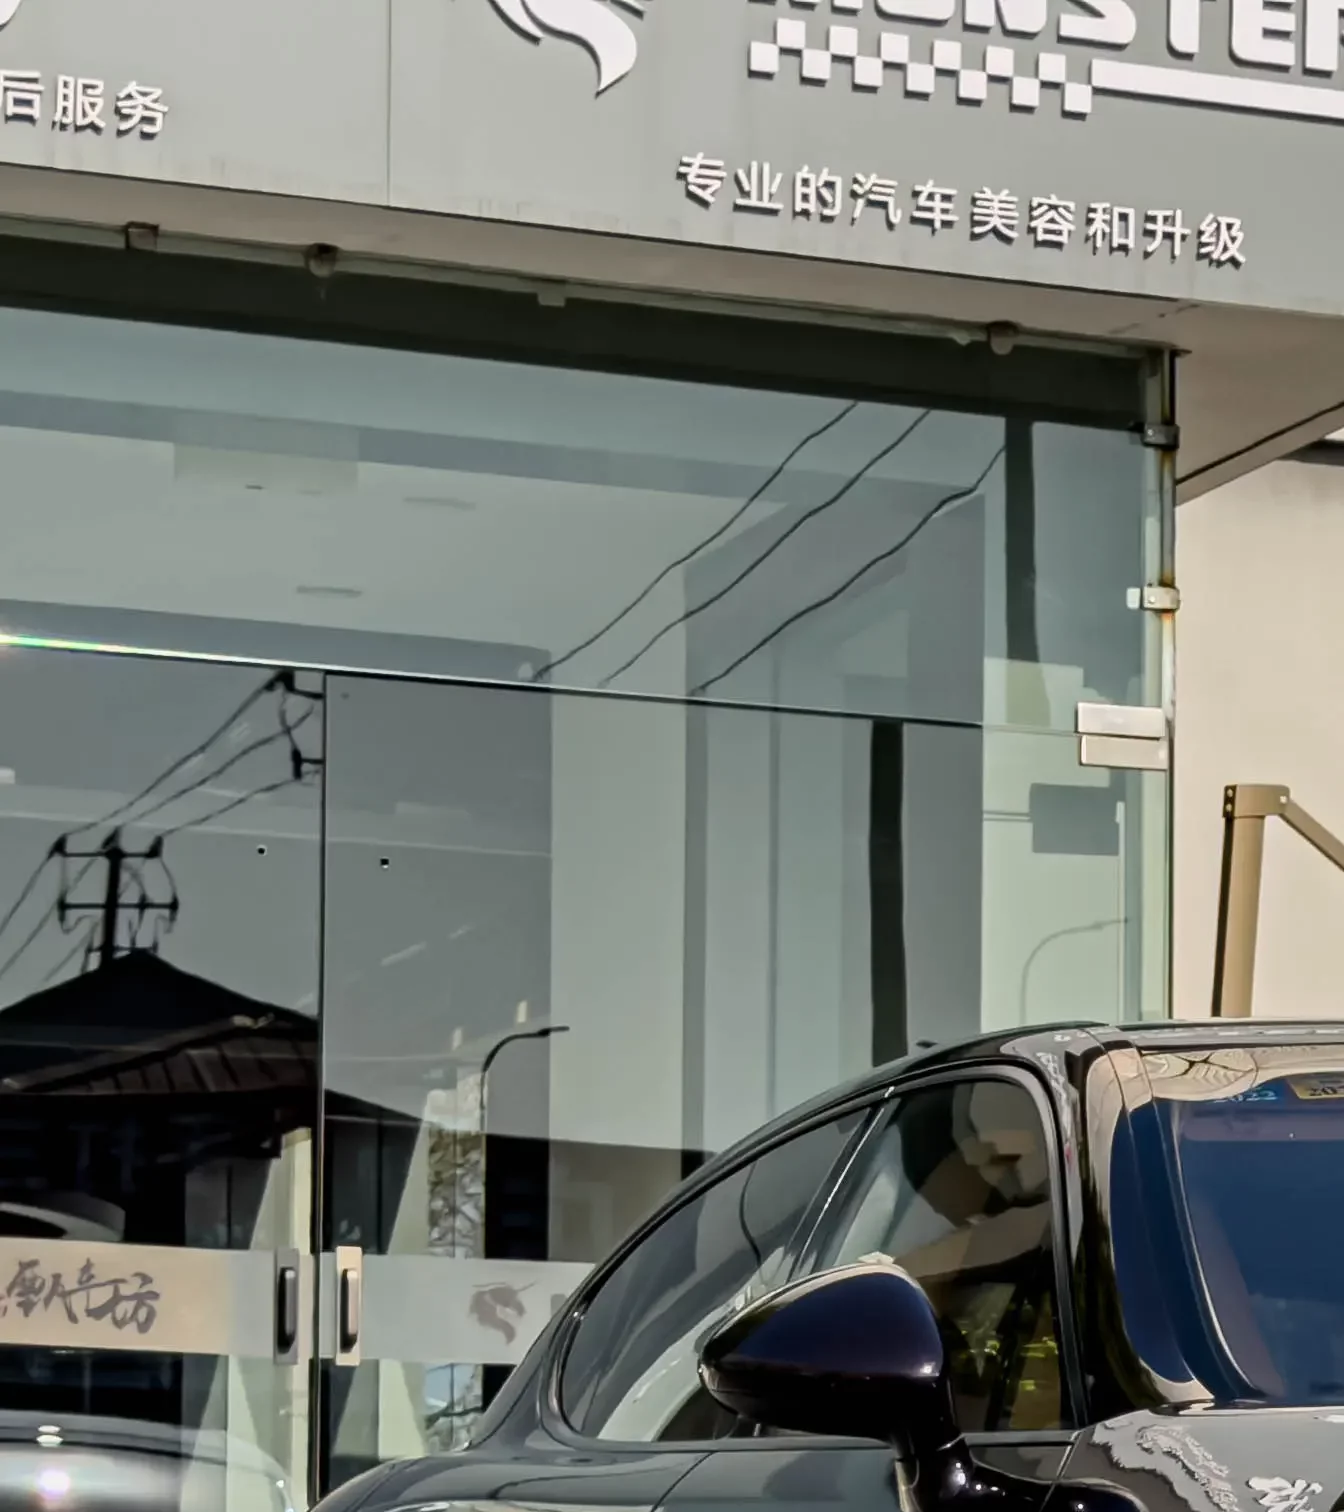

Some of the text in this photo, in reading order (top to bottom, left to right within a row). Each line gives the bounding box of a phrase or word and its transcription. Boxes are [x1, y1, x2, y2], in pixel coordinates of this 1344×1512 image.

[676, 151, 1247, 266] 专业的汽车美容和升级
